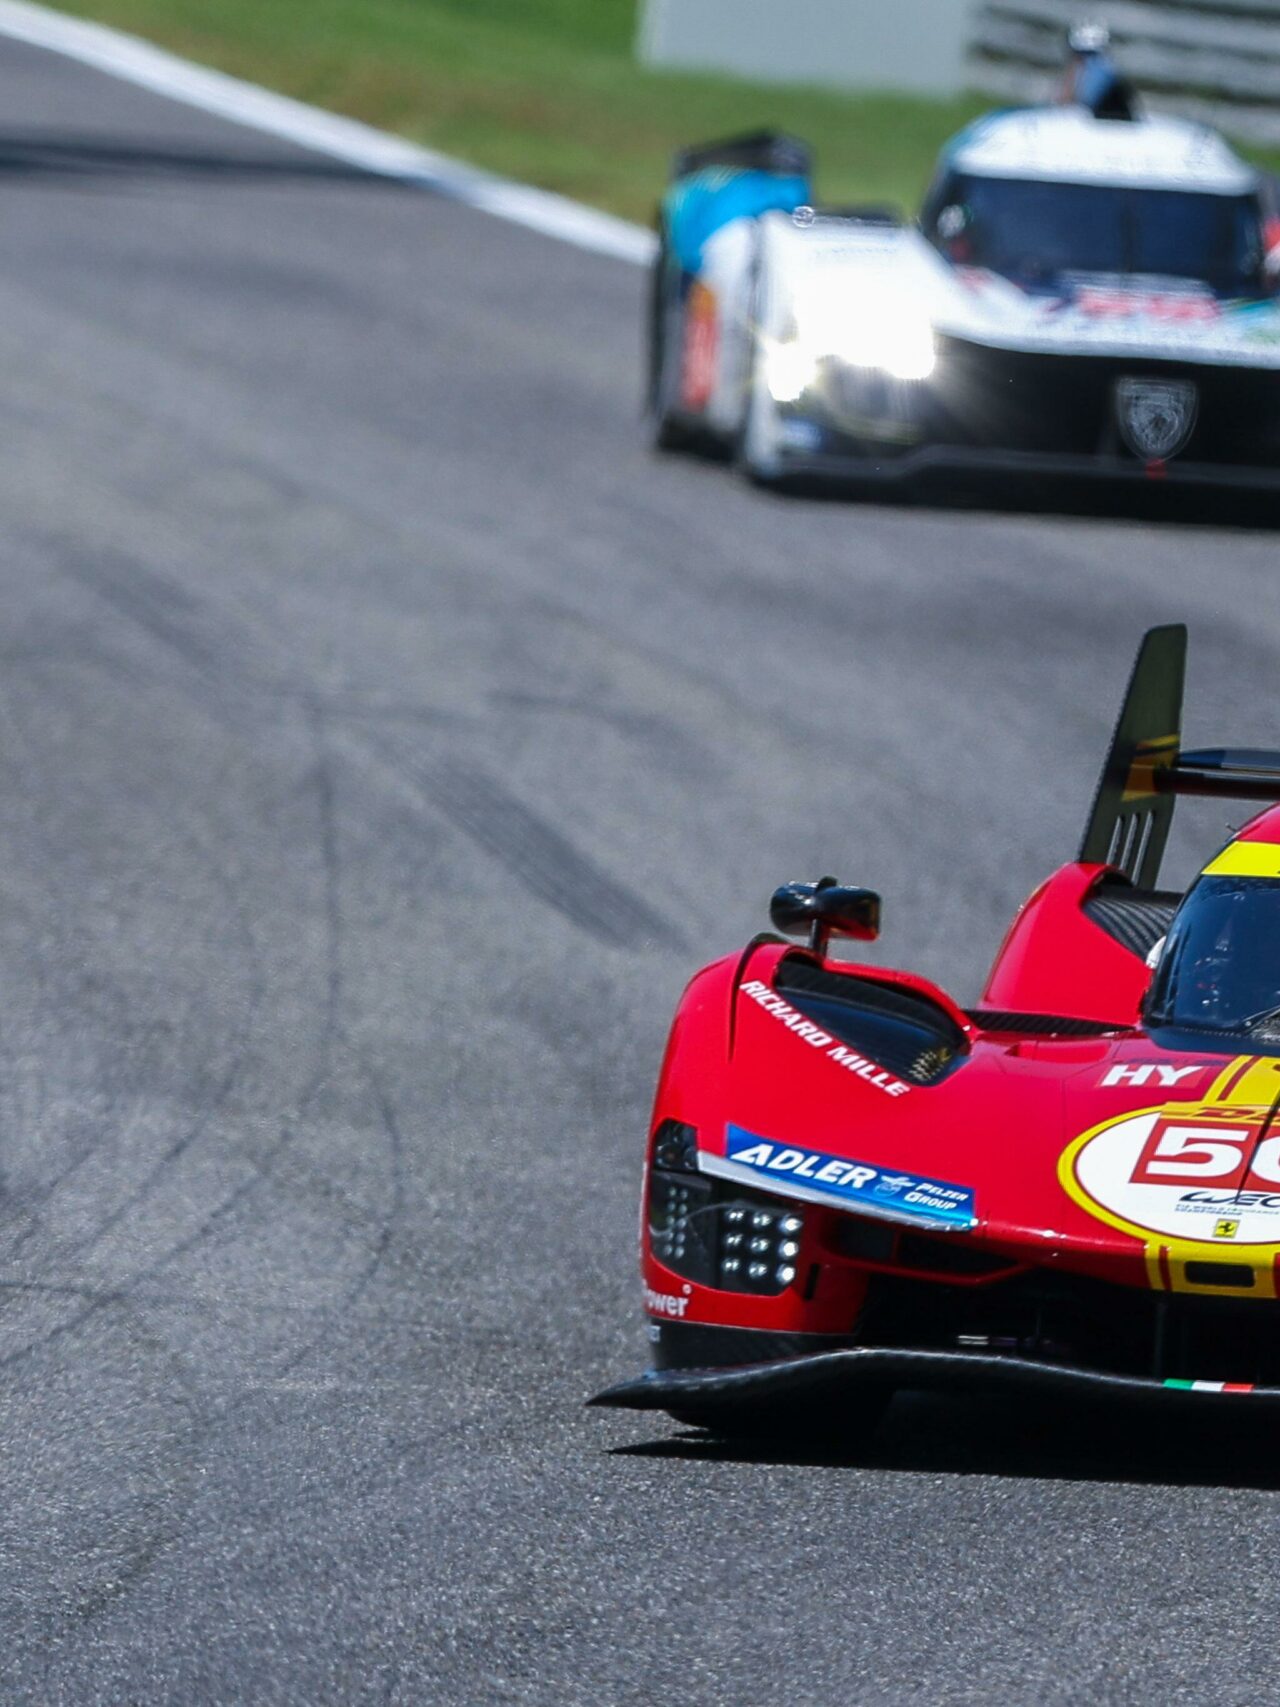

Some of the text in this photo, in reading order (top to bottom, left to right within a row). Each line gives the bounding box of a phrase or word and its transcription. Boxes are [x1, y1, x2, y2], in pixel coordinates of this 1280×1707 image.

[739, 980, 911, 1097] RICHARD MILLE
[1100, 1064, 1204, 1087] HY
[730, 1142, 877, 1190] ADLER
[904, 1191, 957, 1210] GROUP
[915, 1183, 969, 1201] PELZER
